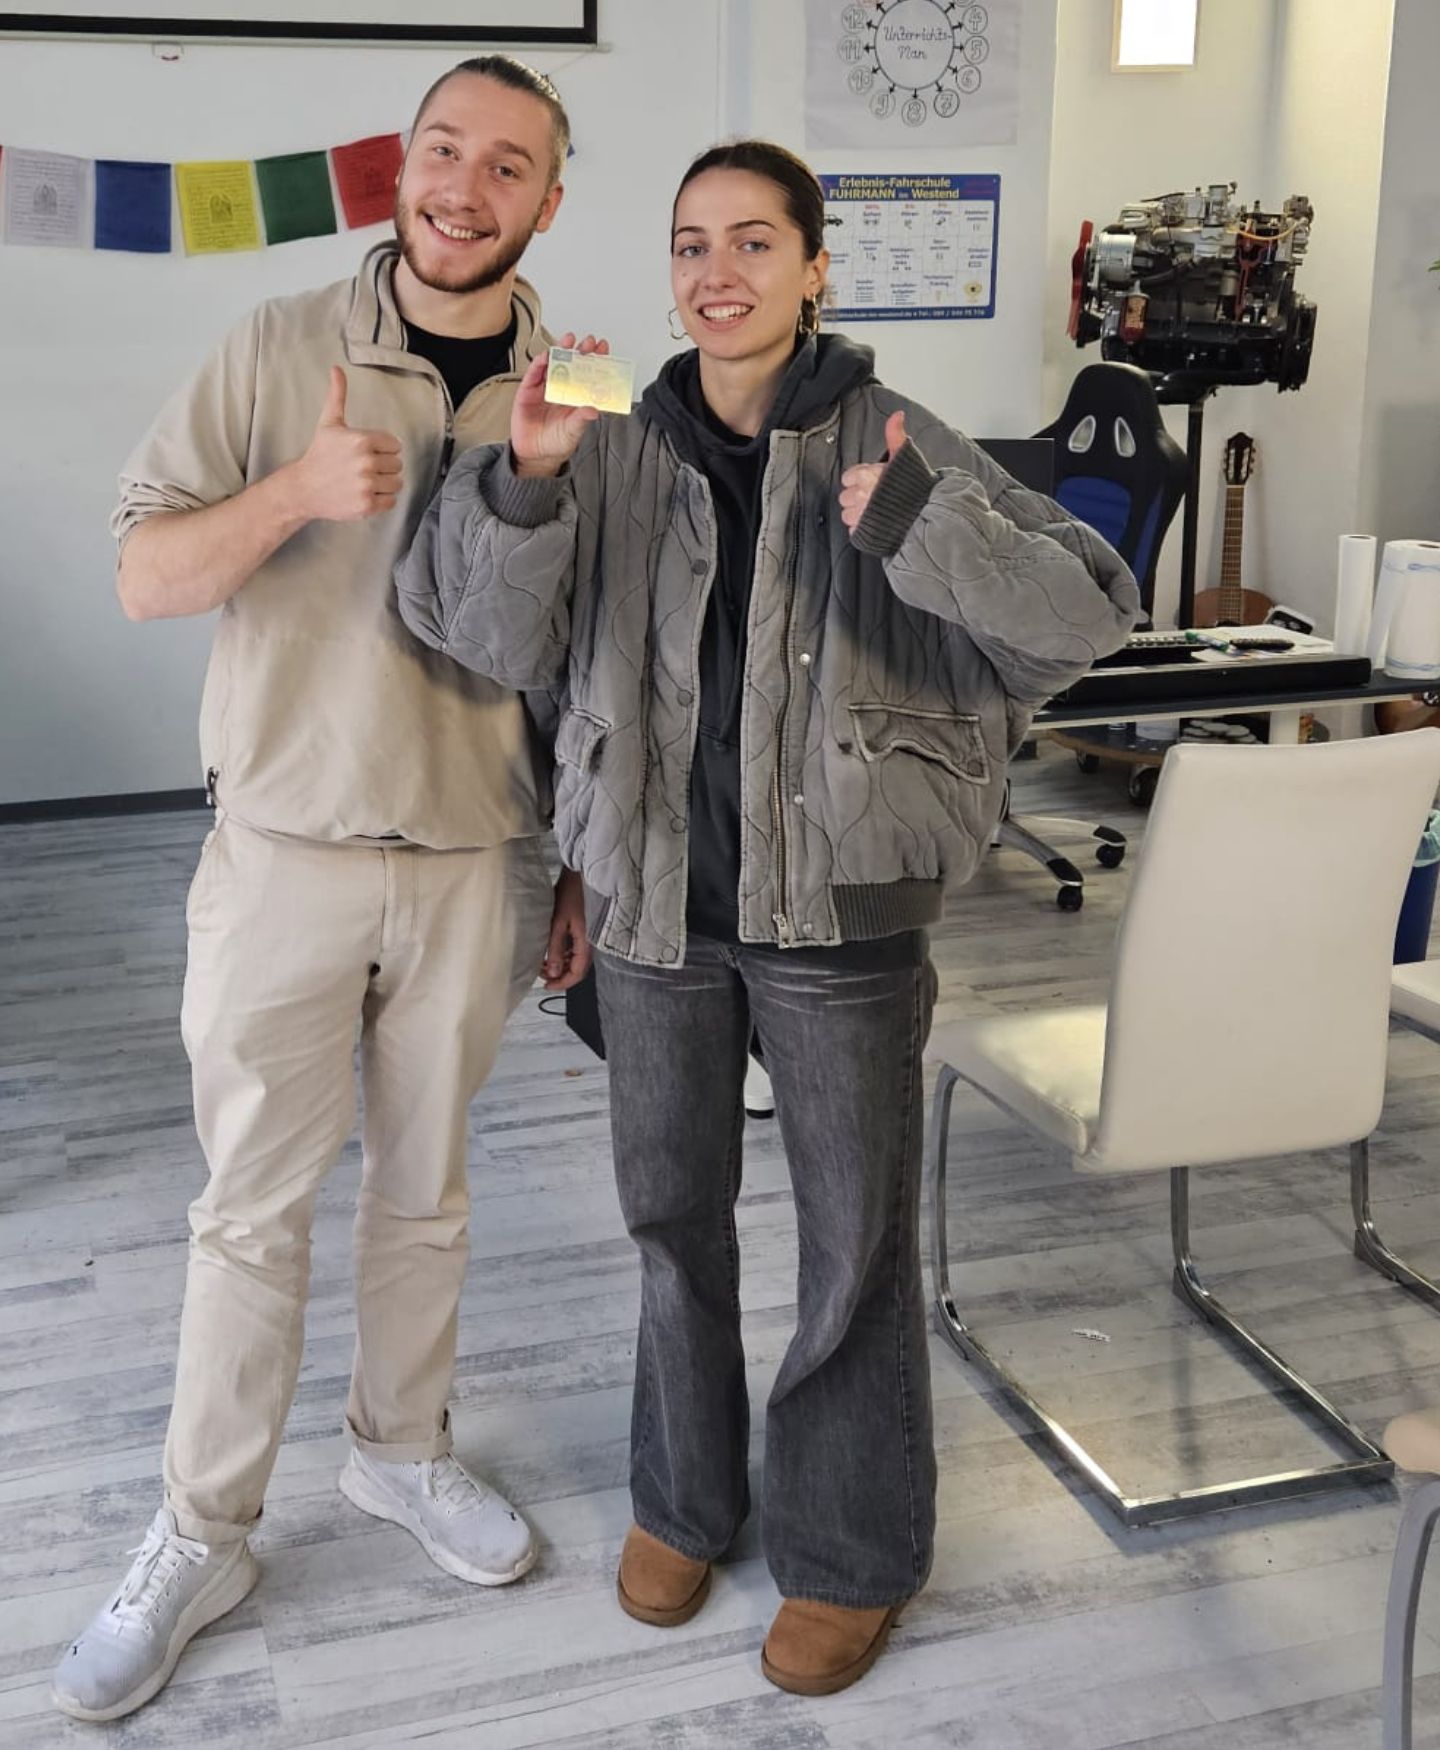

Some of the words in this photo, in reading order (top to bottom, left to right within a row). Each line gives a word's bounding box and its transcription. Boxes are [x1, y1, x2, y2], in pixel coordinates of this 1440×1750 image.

[968, 7, 983, 32] 4
[970, 39, 983, 60] 5
[906, 101, 922, 123] 8
[839, 177, 951, 188] Erlebnis-Fahrschule
[829, 188, 896, 199] FUHRMANN
[911, 188, 960, 199] Westend
